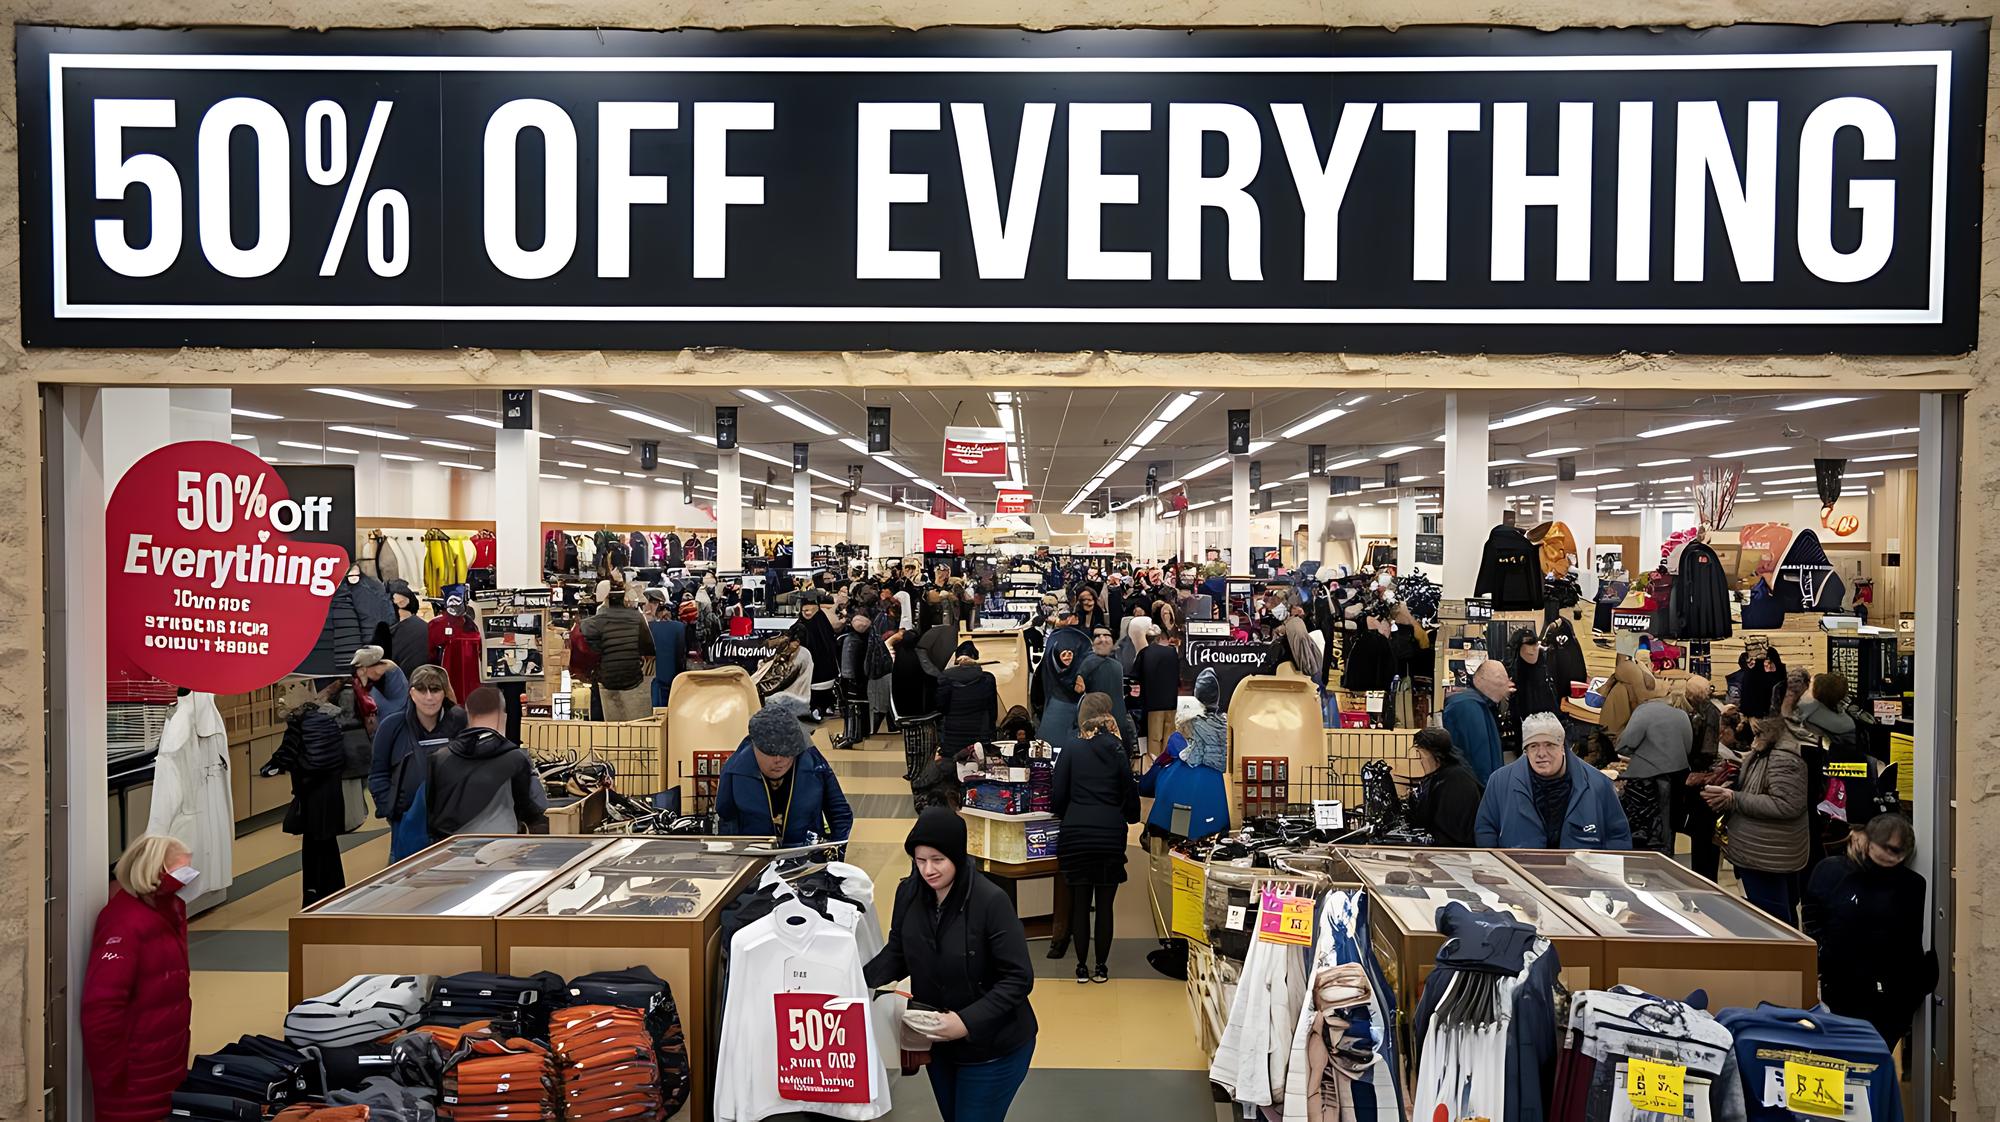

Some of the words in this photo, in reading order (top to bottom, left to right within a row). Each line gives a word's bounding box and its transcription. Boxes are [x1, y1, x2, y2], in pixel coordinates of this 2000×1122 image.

[93, 97, 411, 278] 50%
[483, 98, 775, 280] OFF
[856, 97, 1897, 283] EVERYTHING
[176, 470, 268, 533] 50%
[123, 533, 341, 597] Everything
[788, 1008, 846, 1052] 50%
